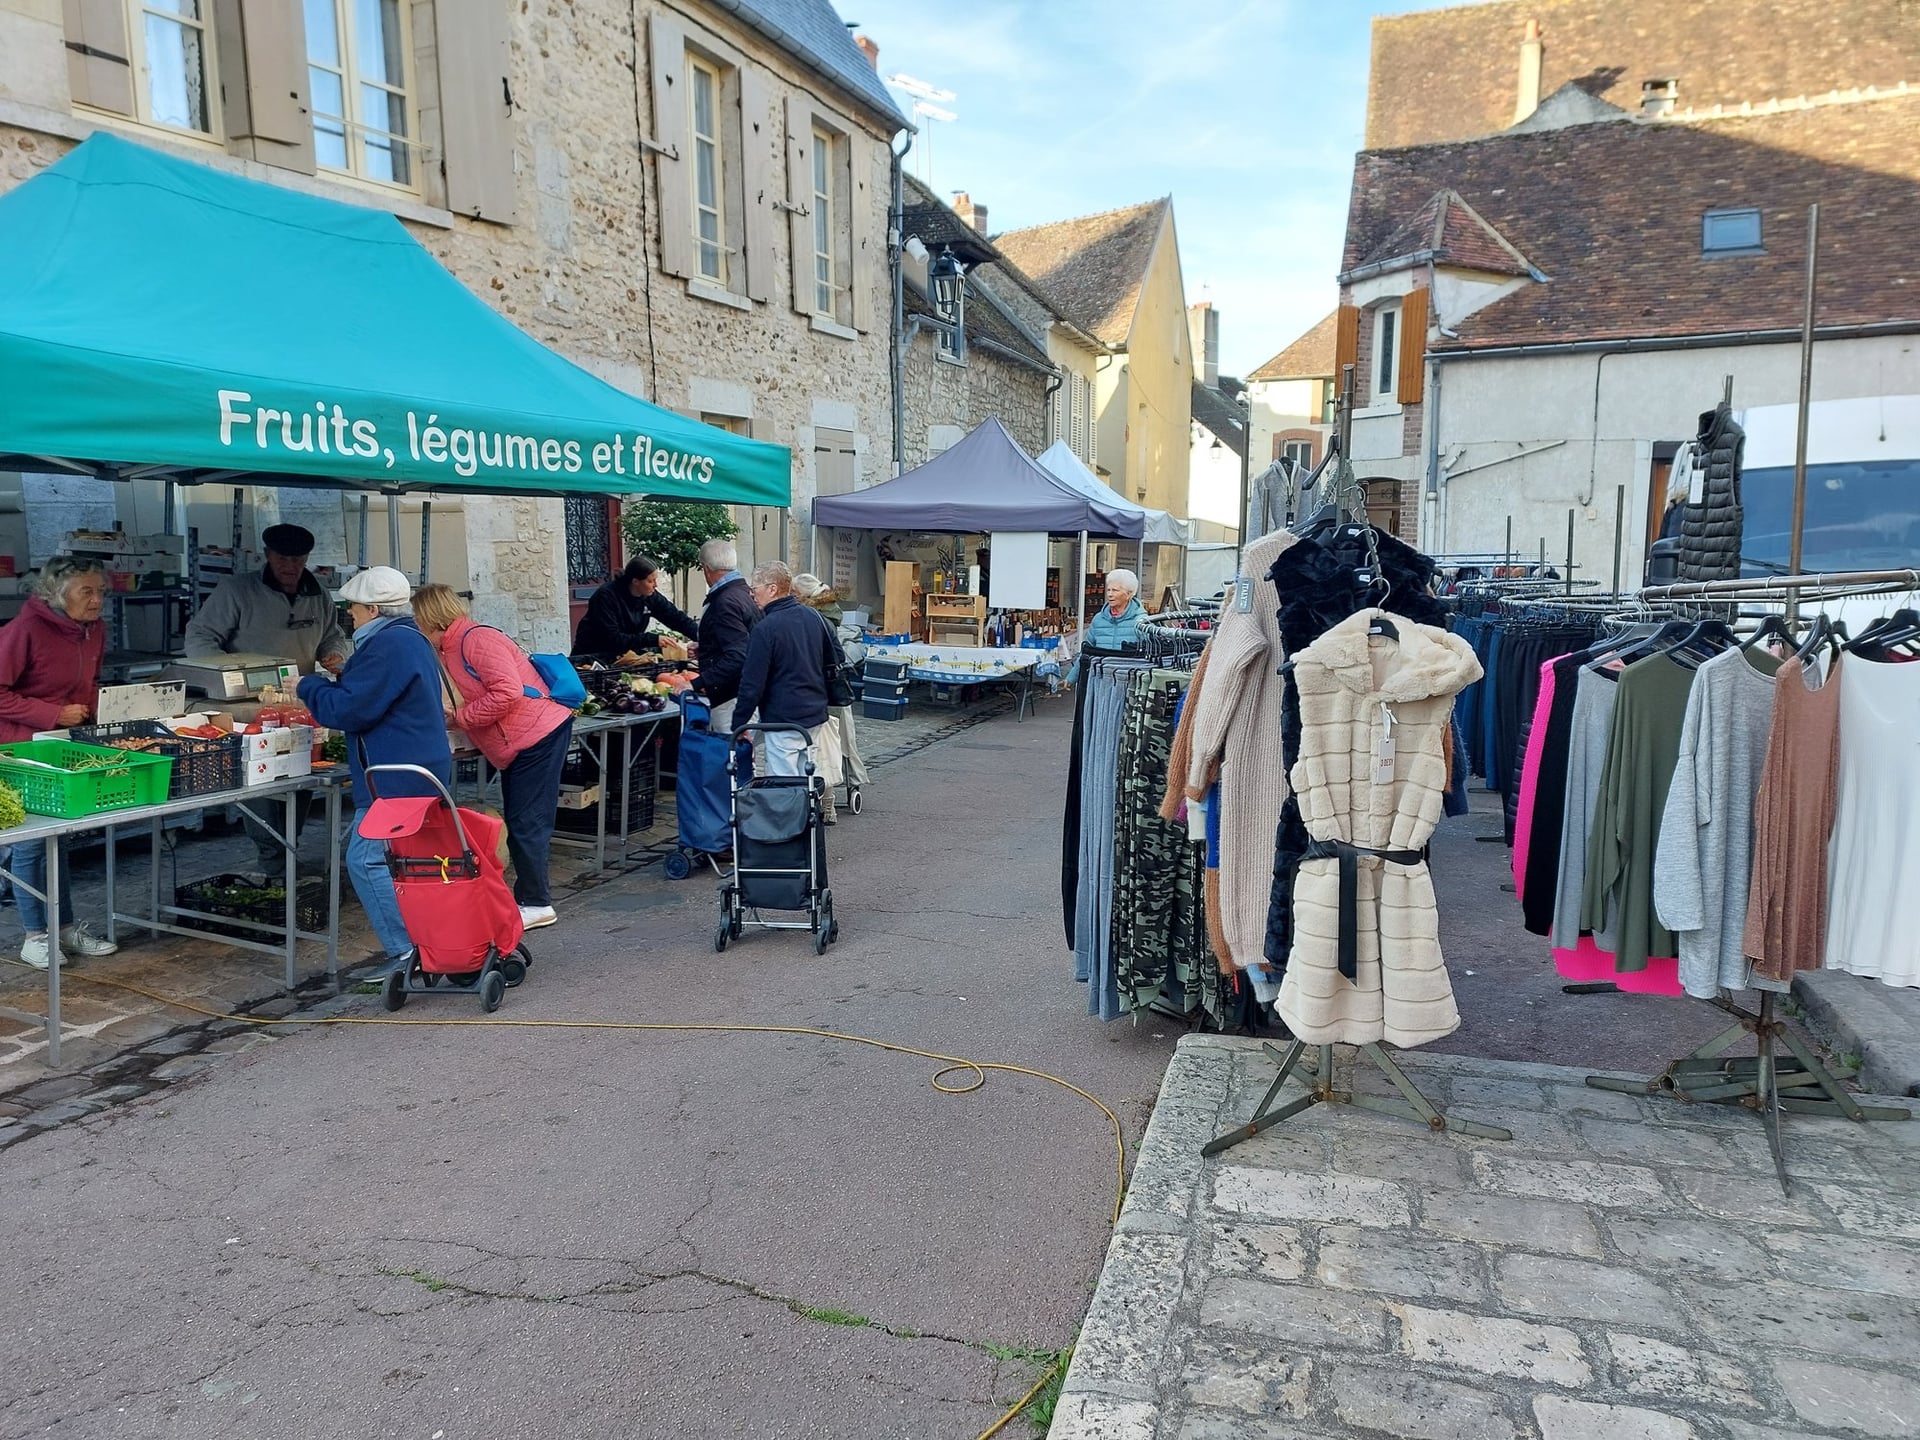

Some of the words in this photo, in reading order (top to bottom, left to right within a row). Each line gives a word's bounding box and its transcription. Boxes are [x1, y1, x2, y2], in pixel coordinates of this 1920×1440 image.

[217, 389, 395, 468] Fruits,
[407, 411, 582, 477] légumes
[592, 433, 625, 474] et
[632, 436, 716, 484] fleurs
